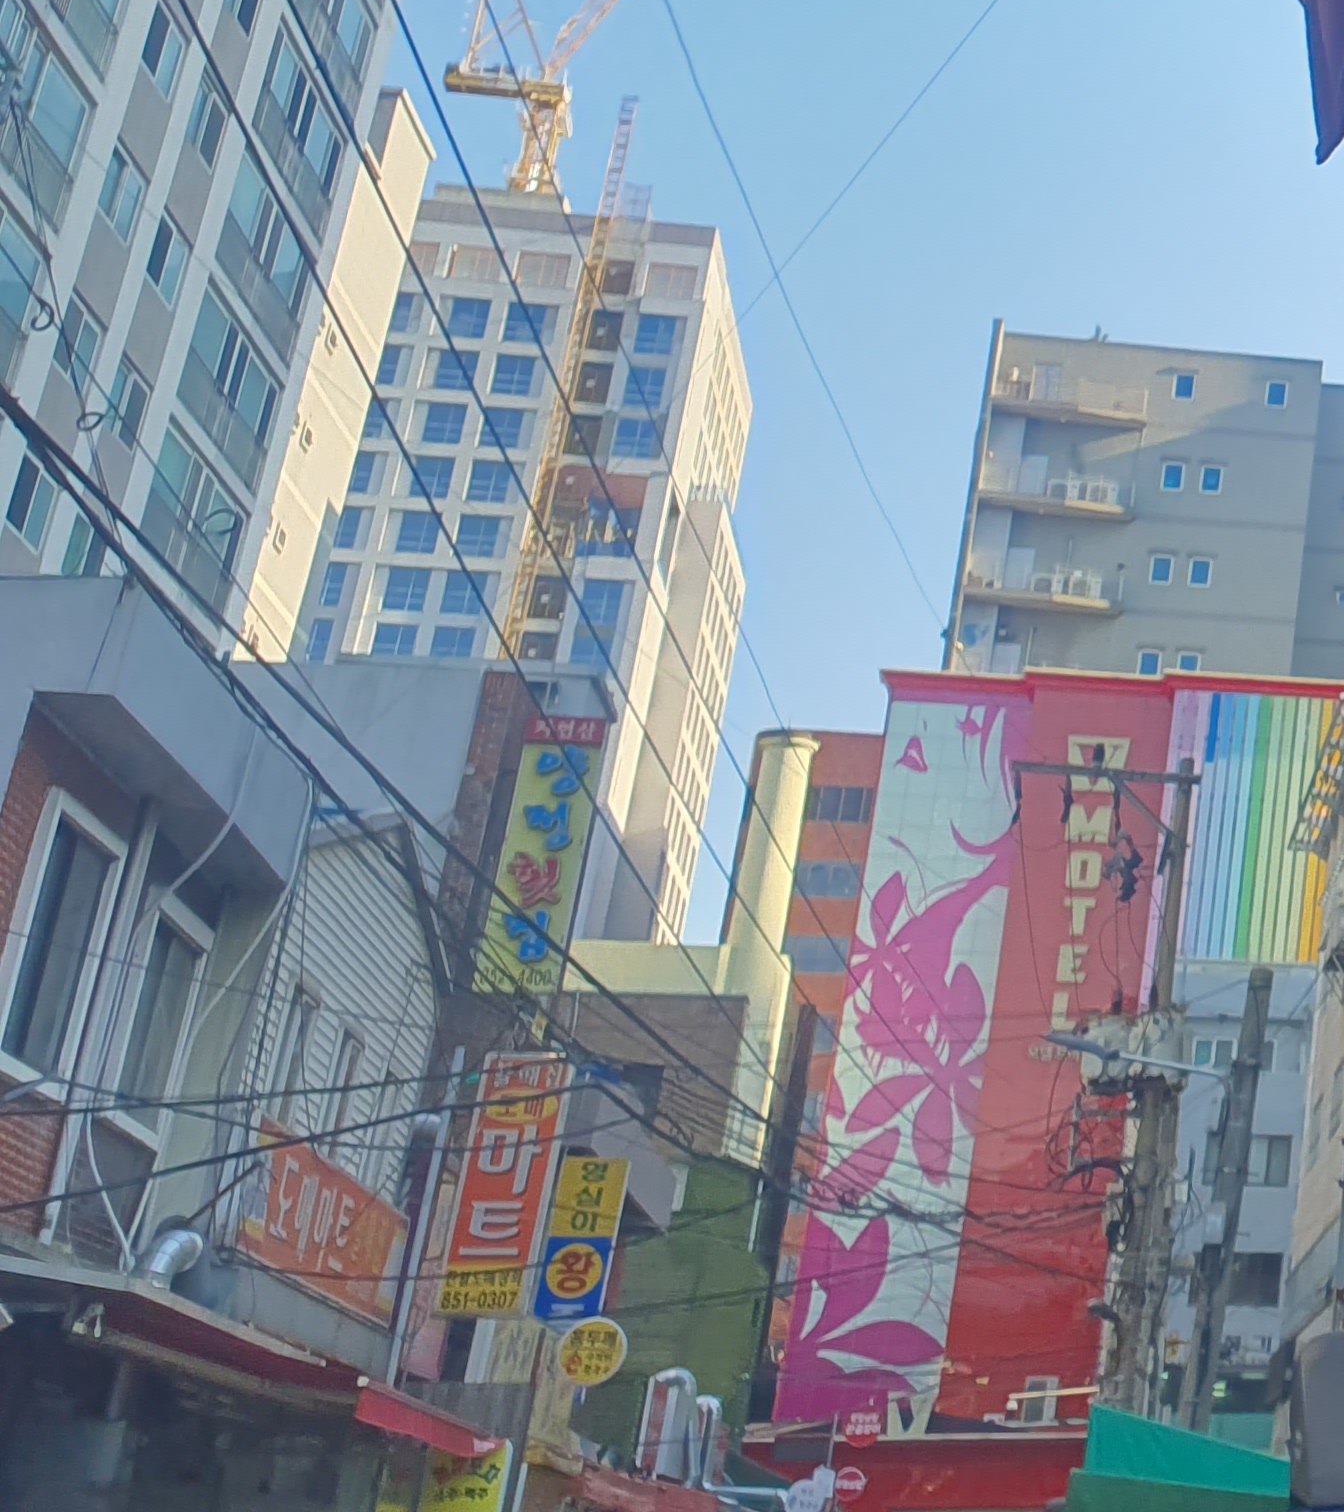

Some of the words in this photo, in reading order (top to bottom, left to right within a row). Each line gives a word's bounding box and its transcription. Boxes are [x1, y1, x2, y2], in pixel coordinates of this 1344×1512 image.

[1051, 805, 1114, 1030] MOTEL
[269, 1153, 356, 1273] 도매마트
[458, 1123, 543, 1257] 마트
[440, 1289, 519, 1309] 851-0307
